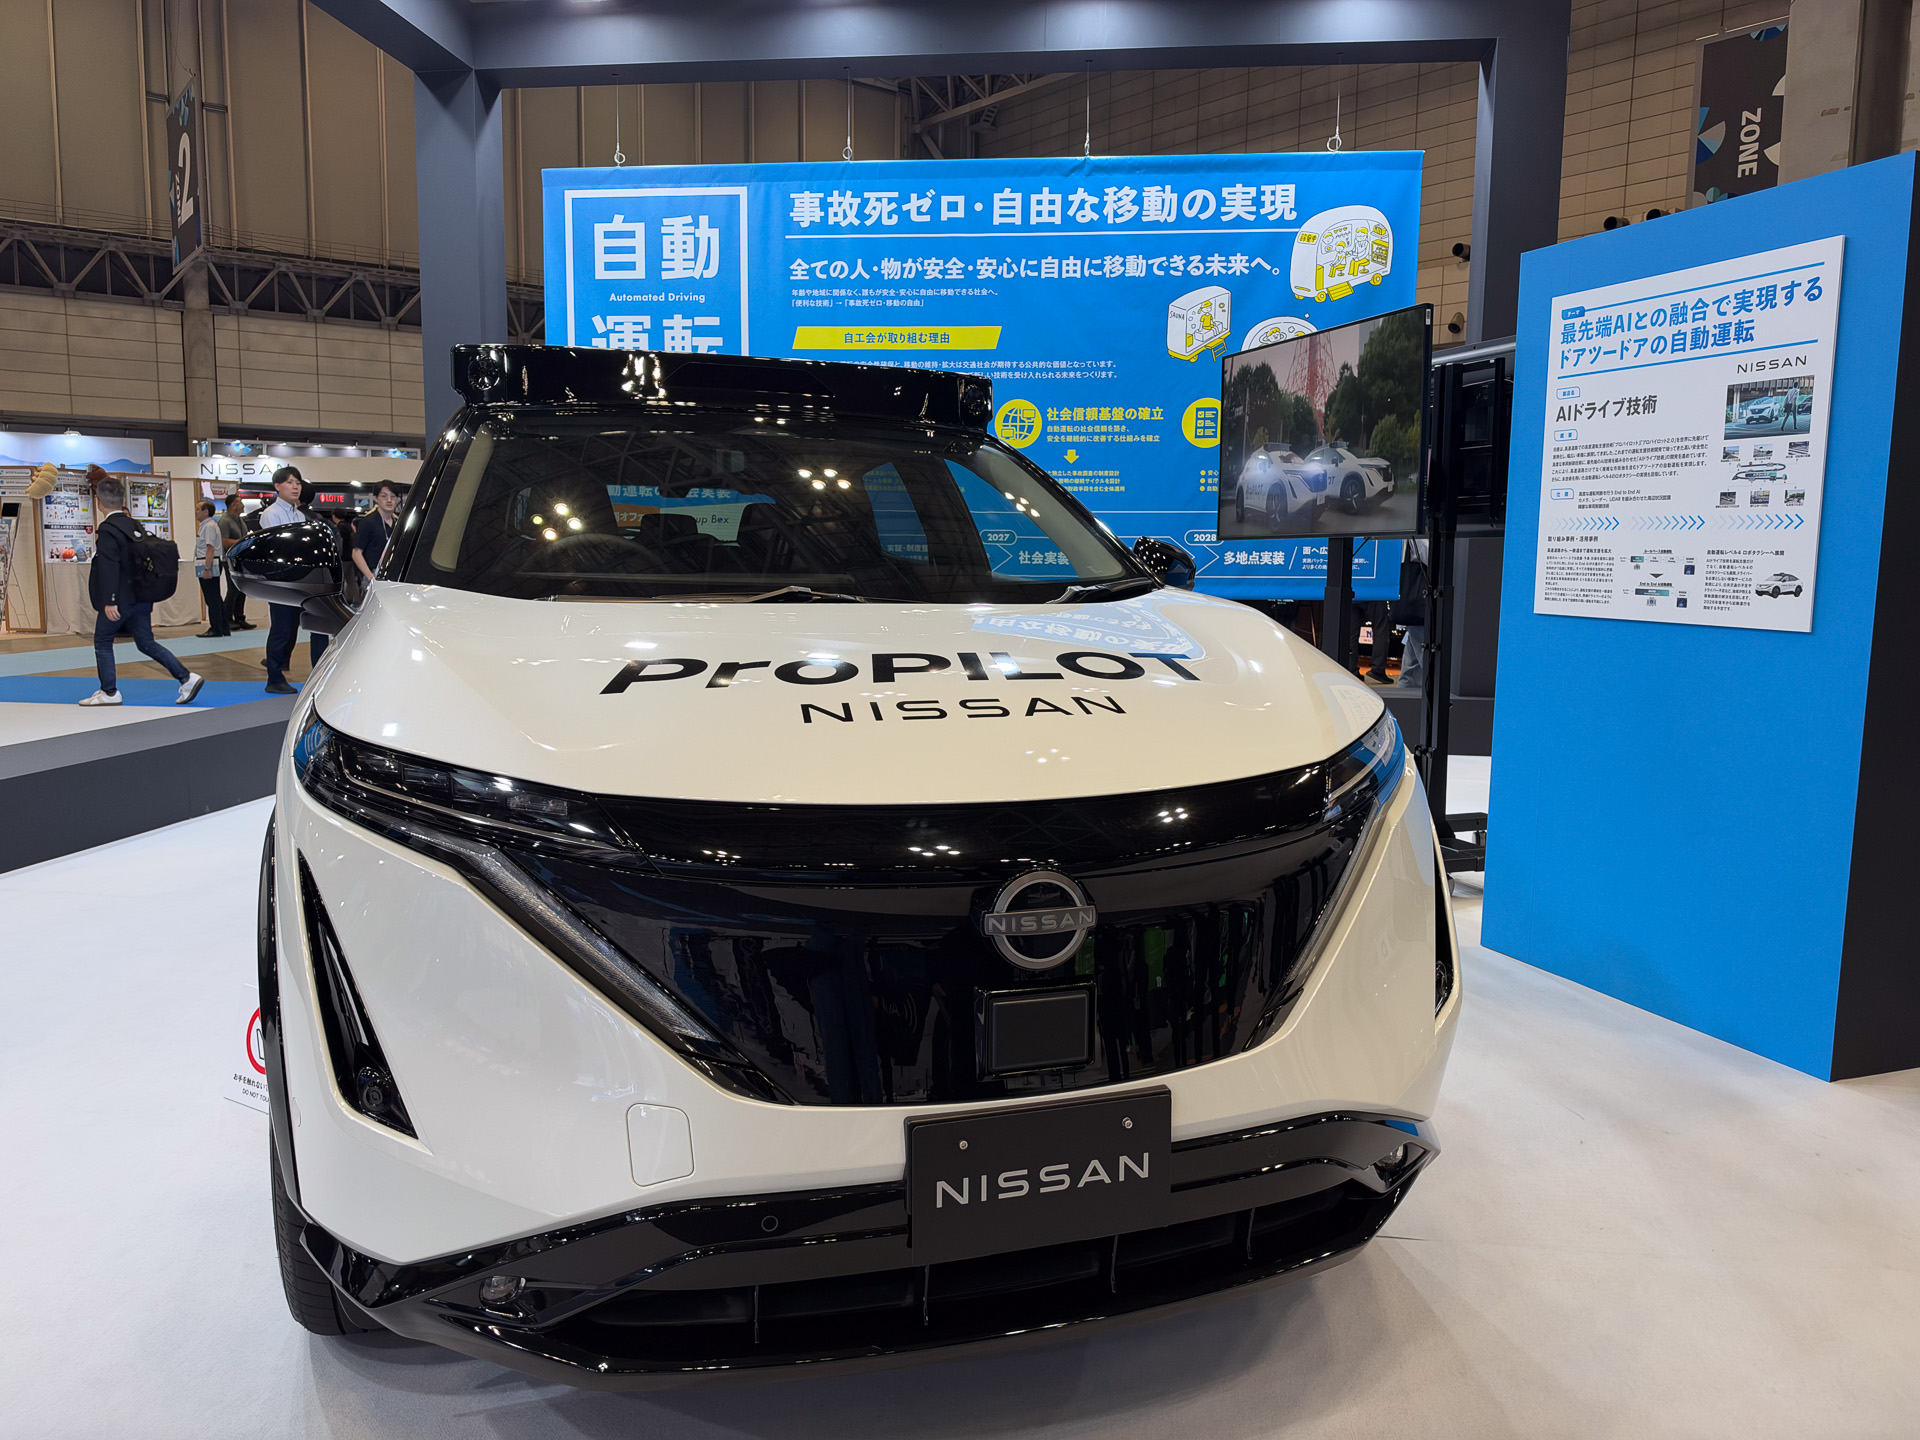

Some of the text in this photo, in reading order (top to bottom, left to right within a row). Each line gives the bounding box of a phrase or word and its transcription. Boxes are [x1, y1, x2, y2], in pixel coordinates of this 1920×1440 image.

[1737, 107, 1762, 179] ZONE
[178, 132, 194, 225] 2
[789, 183, 1297, 228] 事故死ゼロ・自由な移動の実現
[594, 213, 720, 280] 自動
[789, 252, 1280, 281] 全ての人・物が安全・安心に自由に移動できる未来へ。
[609, 292, 706, 304] Automated Driving
[1560, 276, 1823, 346] 最先端AIとの融合で実現する
[844, 331, 950, 344] 自工会が取り組む理由
[1560, 318, 1756, 370] ドアツードアの自動運転
[1736, 355, 1808, 374] NISSAN
[1046, 407, 1164, 422] 社会信頼基盤の確立
[1555, 394, 1658, 422] AIドライブ技術
[325, 494, 345, 503] LOTTE
[711, 514, 730, 524] Box
[987, 533, 1010, 542] 2027
[1193, 534, 1217, 542] 2028
[1018, 551, 1069, 565] 社会実装
[1223, 550, 1285, 566] 多地点実装
[600, 651, 1201, 695] ProPILOT
[800, 696, 1127, 724] NISSAN
[988, 910, 1093, 933] NISSAN
[249, 1091, 259, 1099] NOT
[936, 1152, 1149, 1208] NISSAN
